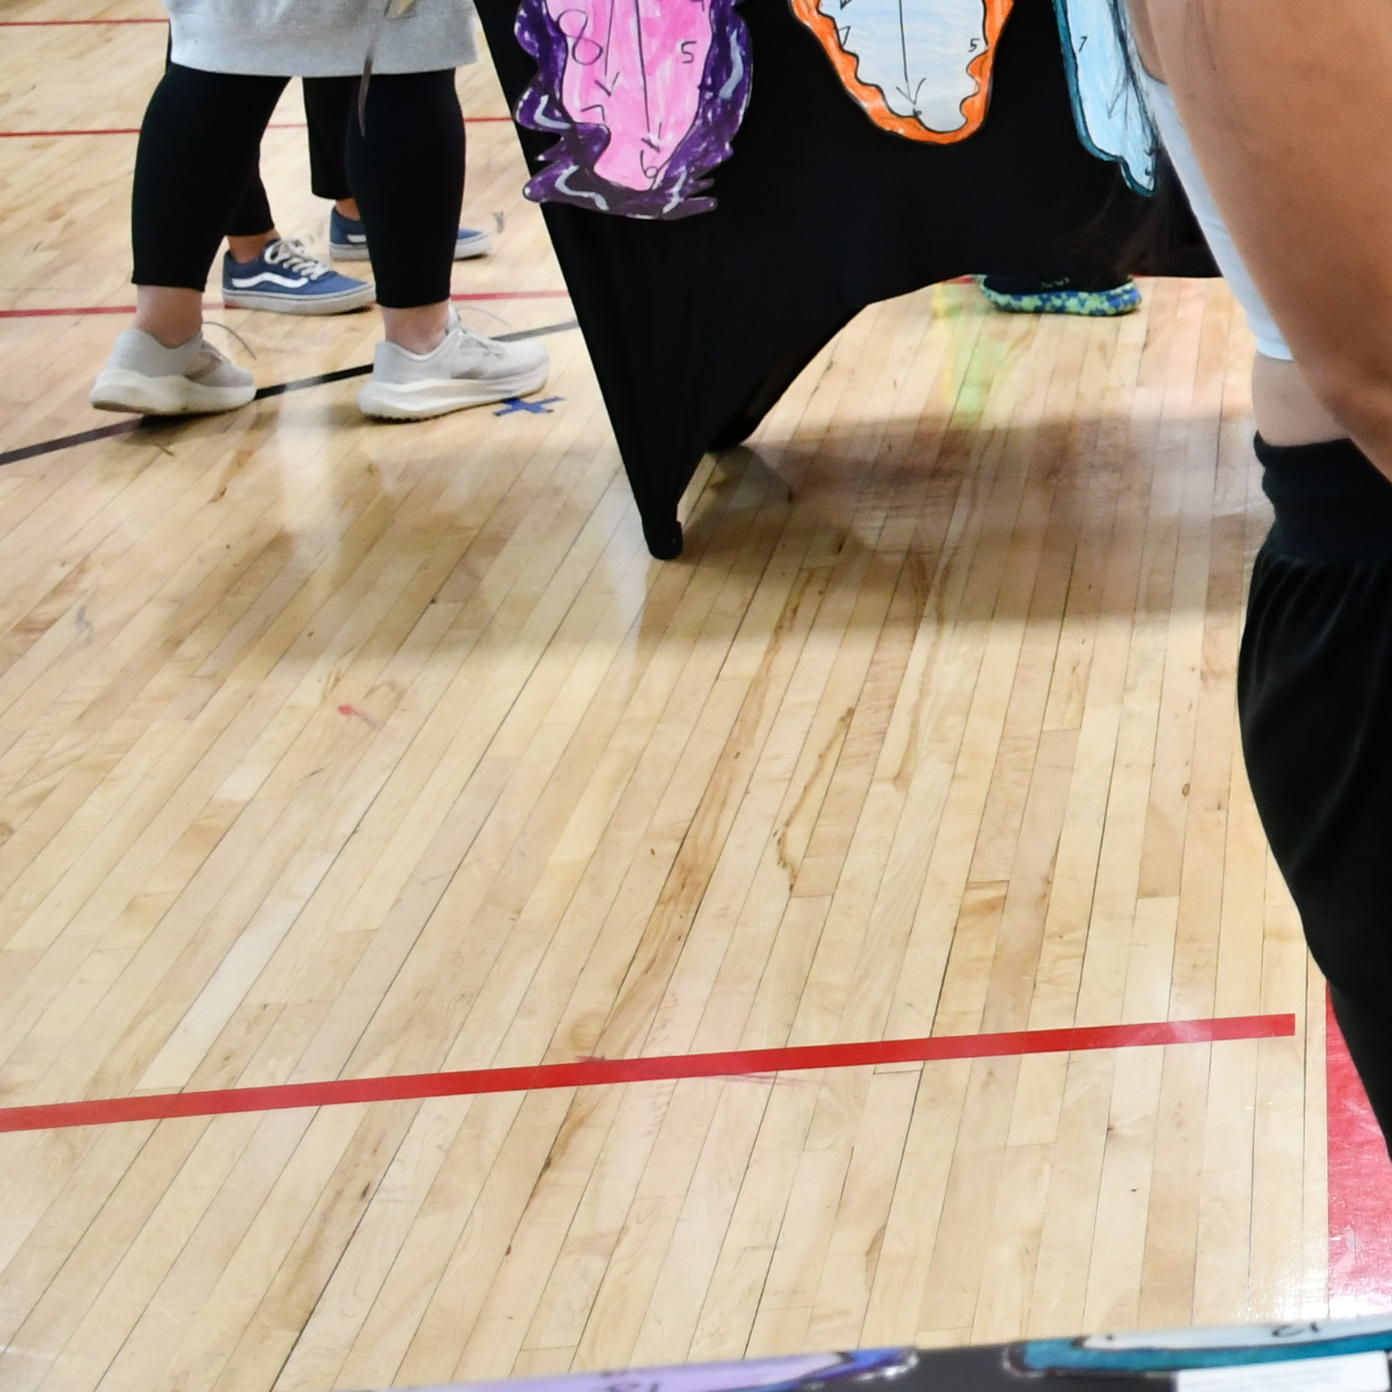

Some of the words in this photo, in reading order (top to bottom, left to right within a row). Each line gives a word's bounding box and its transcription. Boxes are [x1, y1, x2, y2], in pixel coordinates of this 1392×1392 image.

[557, 9, 604, 65] 8
[680, 40, 697, 64] 5
[639, 149, 658, 179] 6
